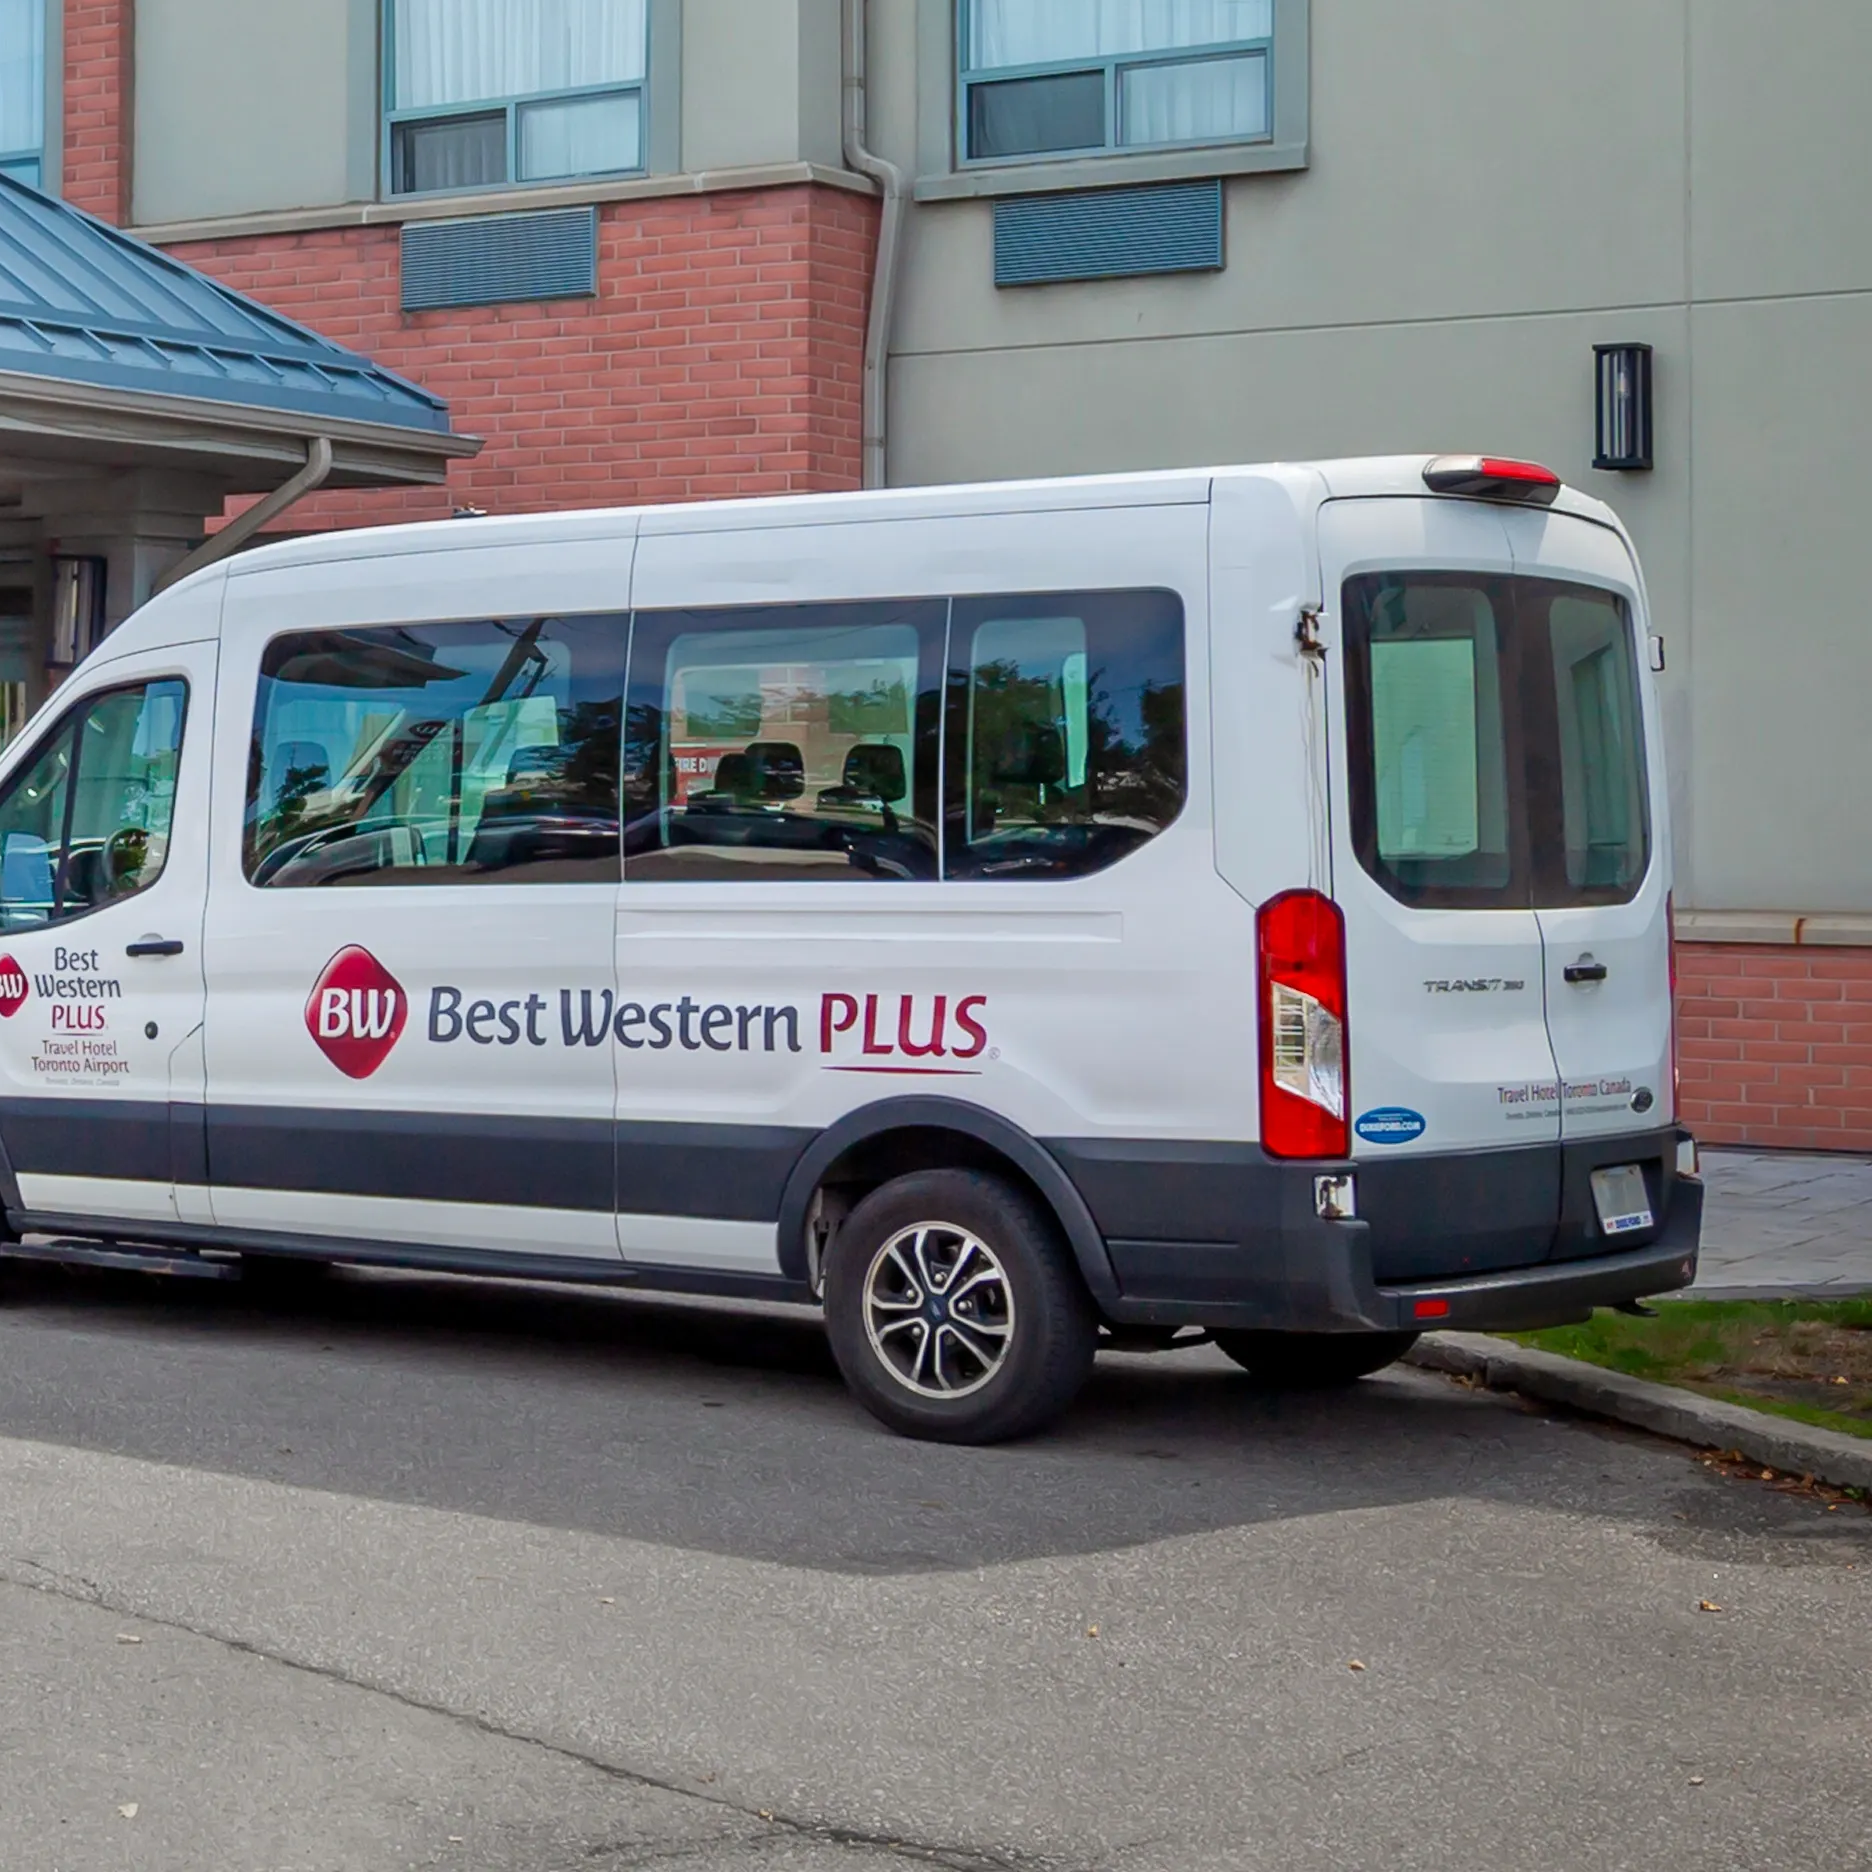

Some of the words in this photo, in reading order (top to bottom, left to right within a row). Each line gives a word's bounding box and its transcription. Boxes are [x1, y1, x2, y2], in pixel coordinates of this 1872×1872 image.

[54, 946, 100, 972] Best
[34, 974, 122, 998] Western
[1423, 978, 1503, 993] TRANSIT
[51, 1004, 106, 1030] PLUS
[319, 987, 396, 1039] BW
[428, 985, 547, 1048] Best
[559, 988, 803, 1053] Western
[819, 992, 988, 1060] PLUS
[42, 1039, 78, 1055] Travel
[82, 1039, 118, 1056] Hotel
[31, 1056, 81, 1073] Toronto
[83, 1057, 130, 1076] Airport
[1497, 1084, 1529, 1104] Travel
[1531, 1083, 1559, 1102] Hotel
[1599, 1076, 1631, 1096] Canada
